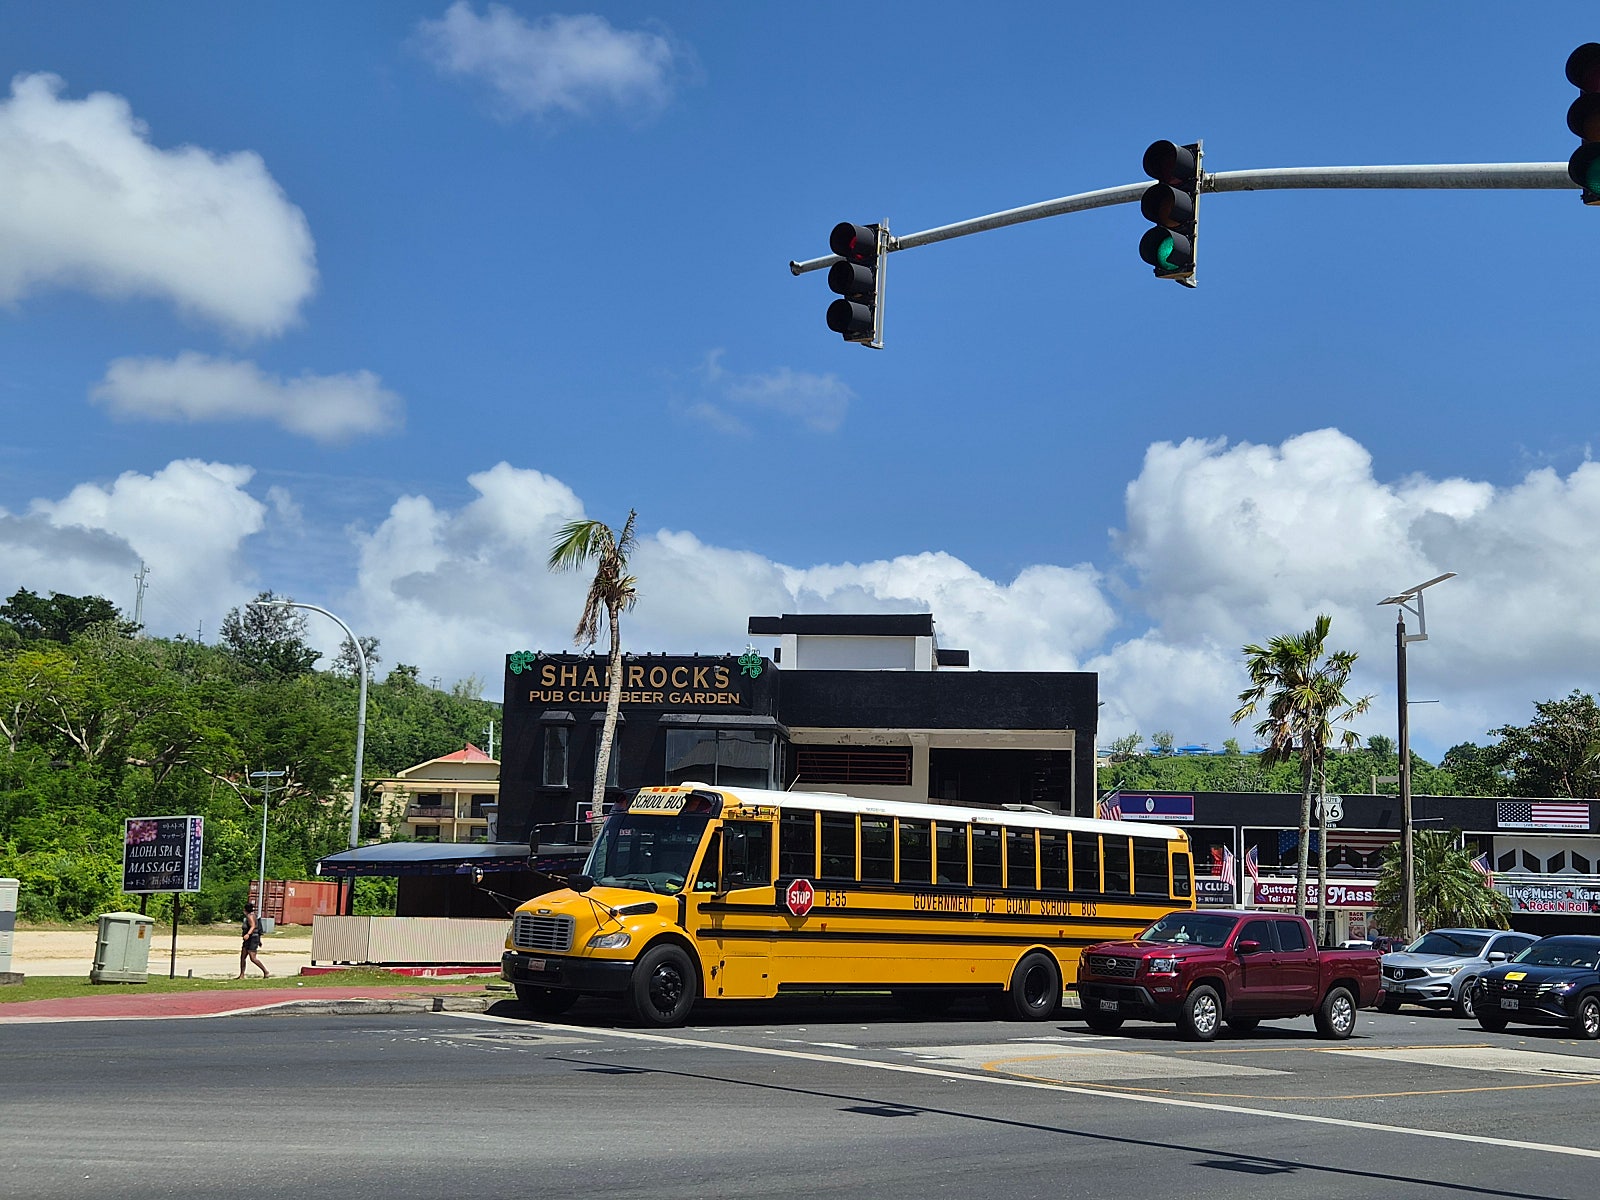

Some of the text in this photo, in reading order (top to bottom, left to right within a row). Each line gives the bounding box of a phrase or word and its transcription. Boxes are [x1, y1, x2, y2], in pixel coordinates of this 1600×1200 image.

[529, 690, 564, 703] PUB
[620, 691, 664, 704] BEER
[668, 692, 740, 704] GARDEN
[632, 794, 684, 809] SCHOOL BUS
[129, 845, 184, 858] ALOHA SPA &
[128, 861, 182, 874] MASSAGE
[1205, 881, 1230, 892] CLUB
[790, 891, 811, 905] STOP
[825, 889, 847, 907] B-55
[1506, 887, 1529, 899] Live
[1531, 887, 1563, 900] Music
[913, 893, 1097, 916] GOVERNMENT OF GUAM SCHOOL BUS
[1529, 900, 1589, 913] Rock N Roll
